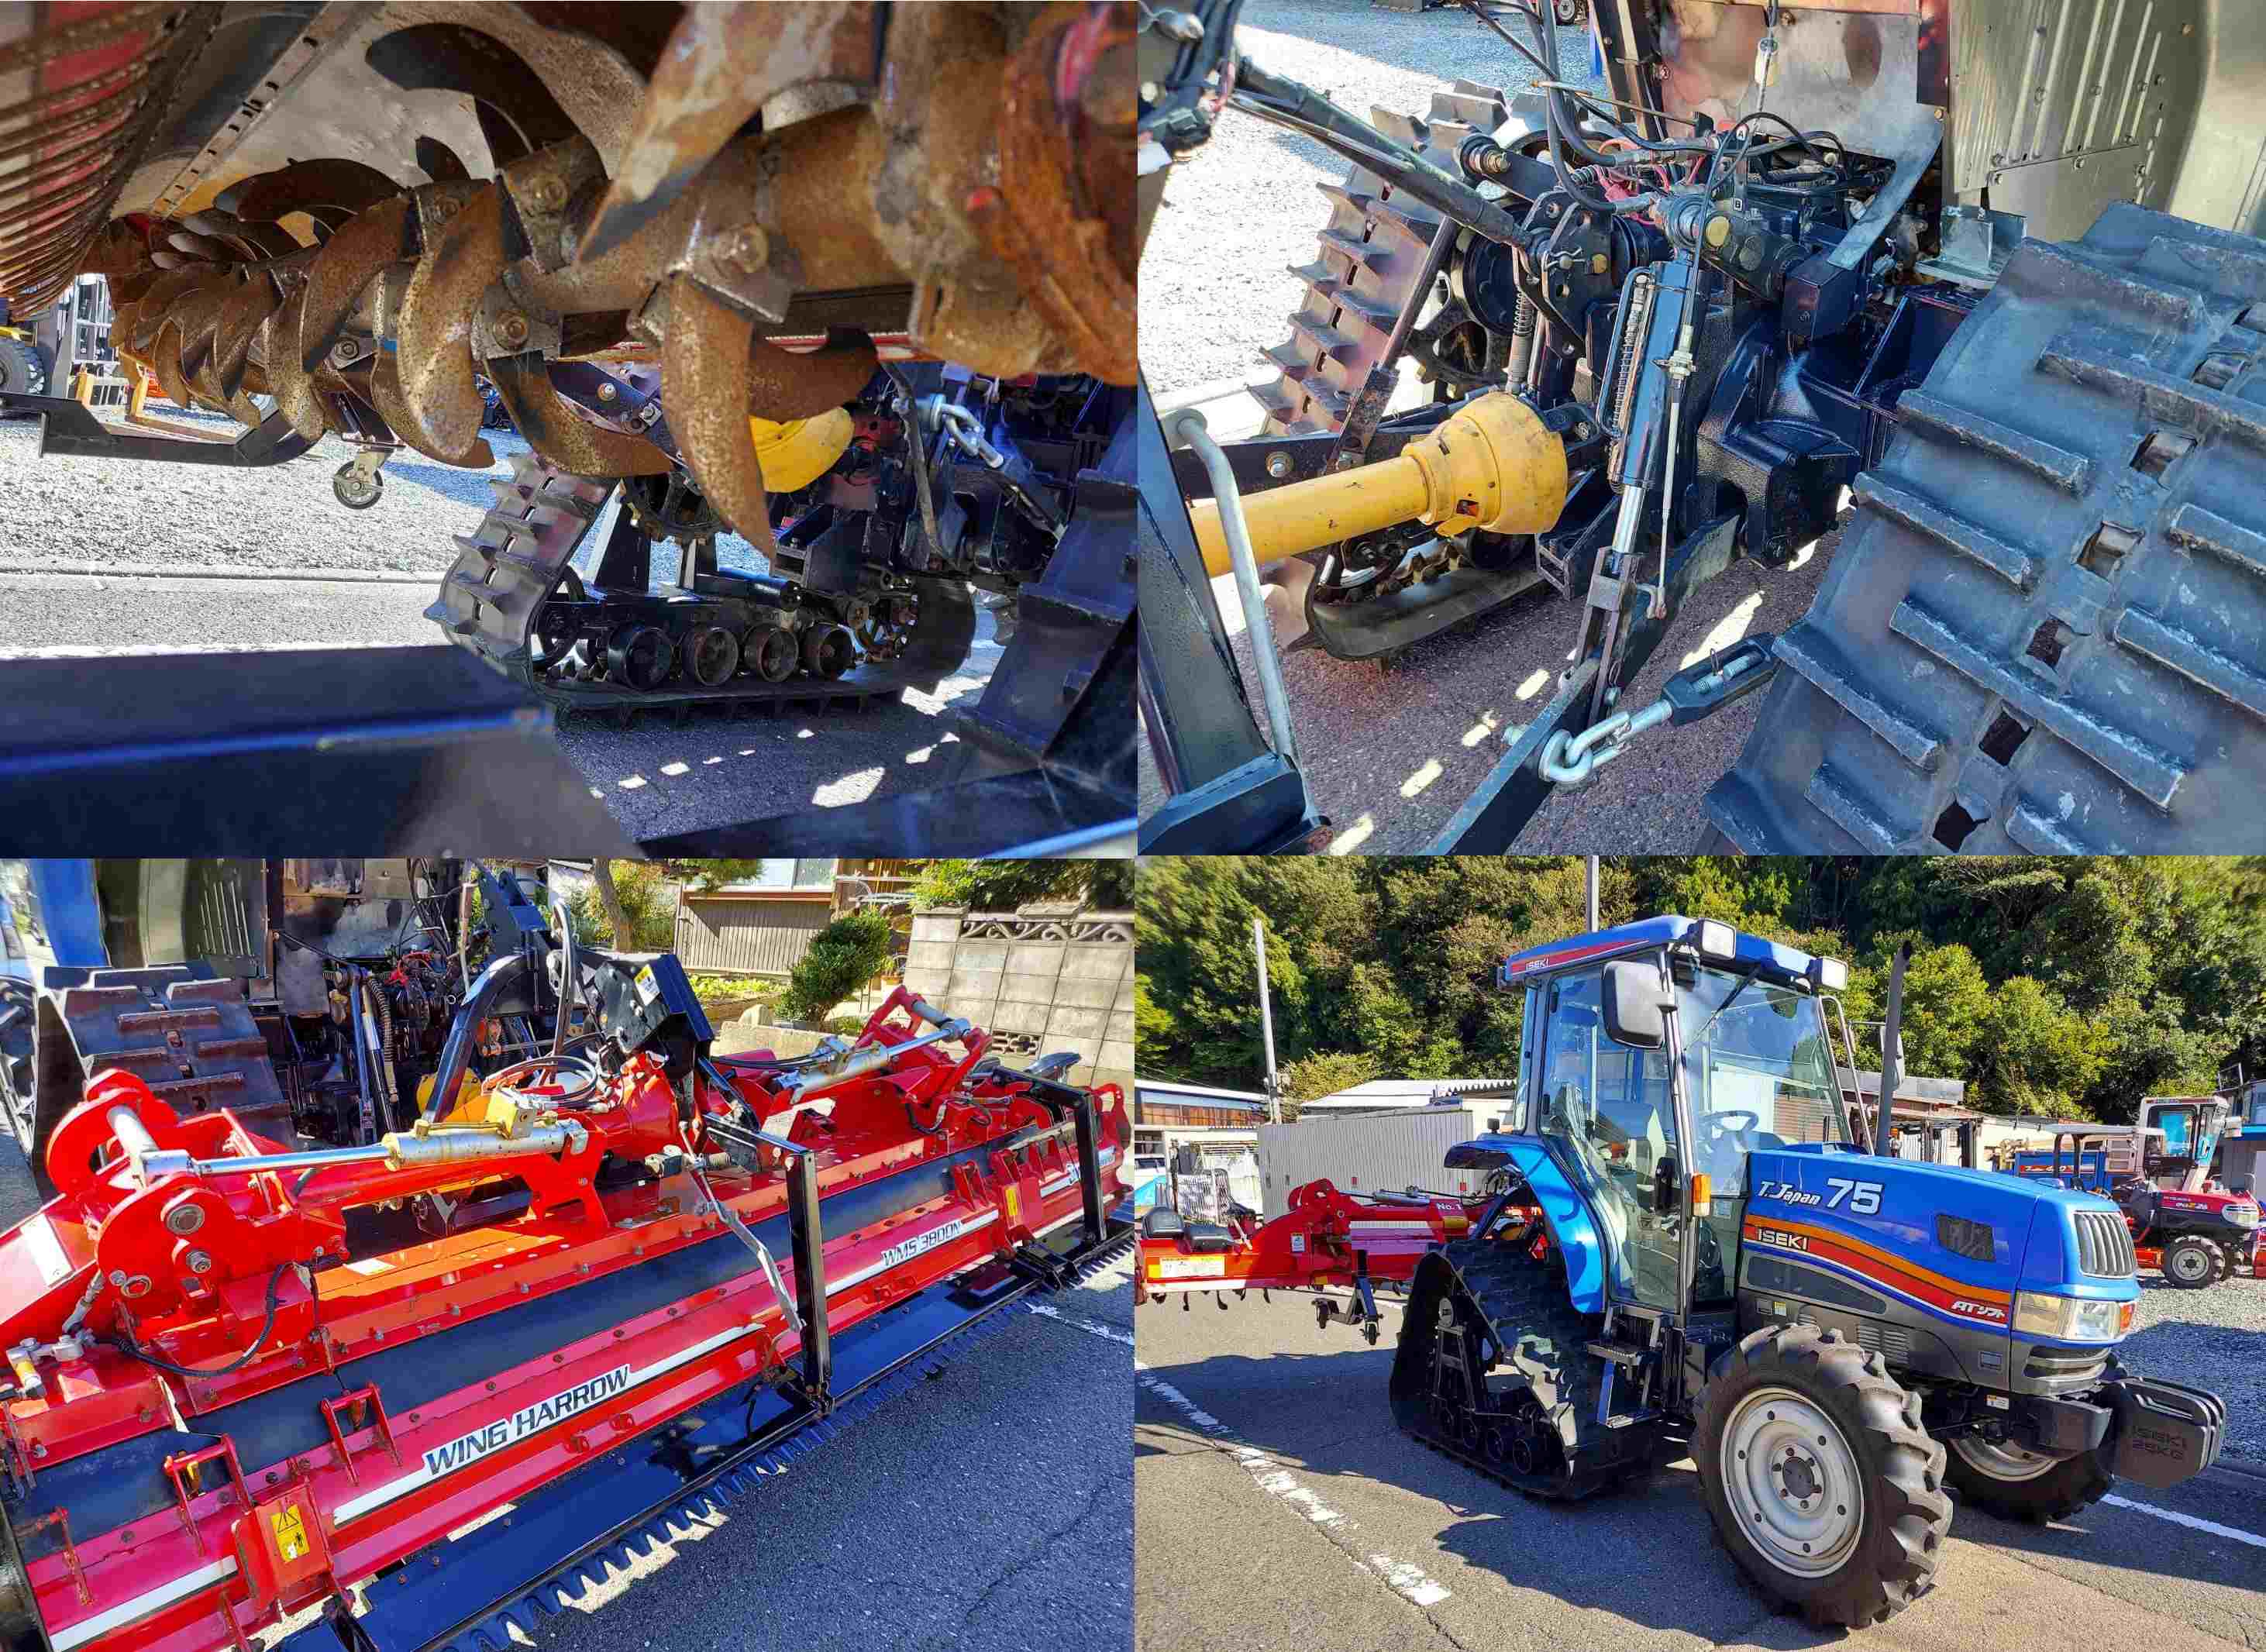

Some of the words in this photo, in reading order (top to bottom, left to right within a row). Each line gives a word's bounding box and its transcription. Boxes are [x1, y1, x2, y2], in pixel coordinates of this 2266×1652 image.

[1525, 958, 1550, 971] ISEKI
[1827, 1178, 1883, 1214] 75
[883, 1239, 918, 1267] WMS
[919, 1220, 961, 1251] 3800N
[1757, 1228, 1808, 1251] ISEKI
[425, 1420, 508, 1475] WING
[515, 1366, 628, 1436] HARROW
